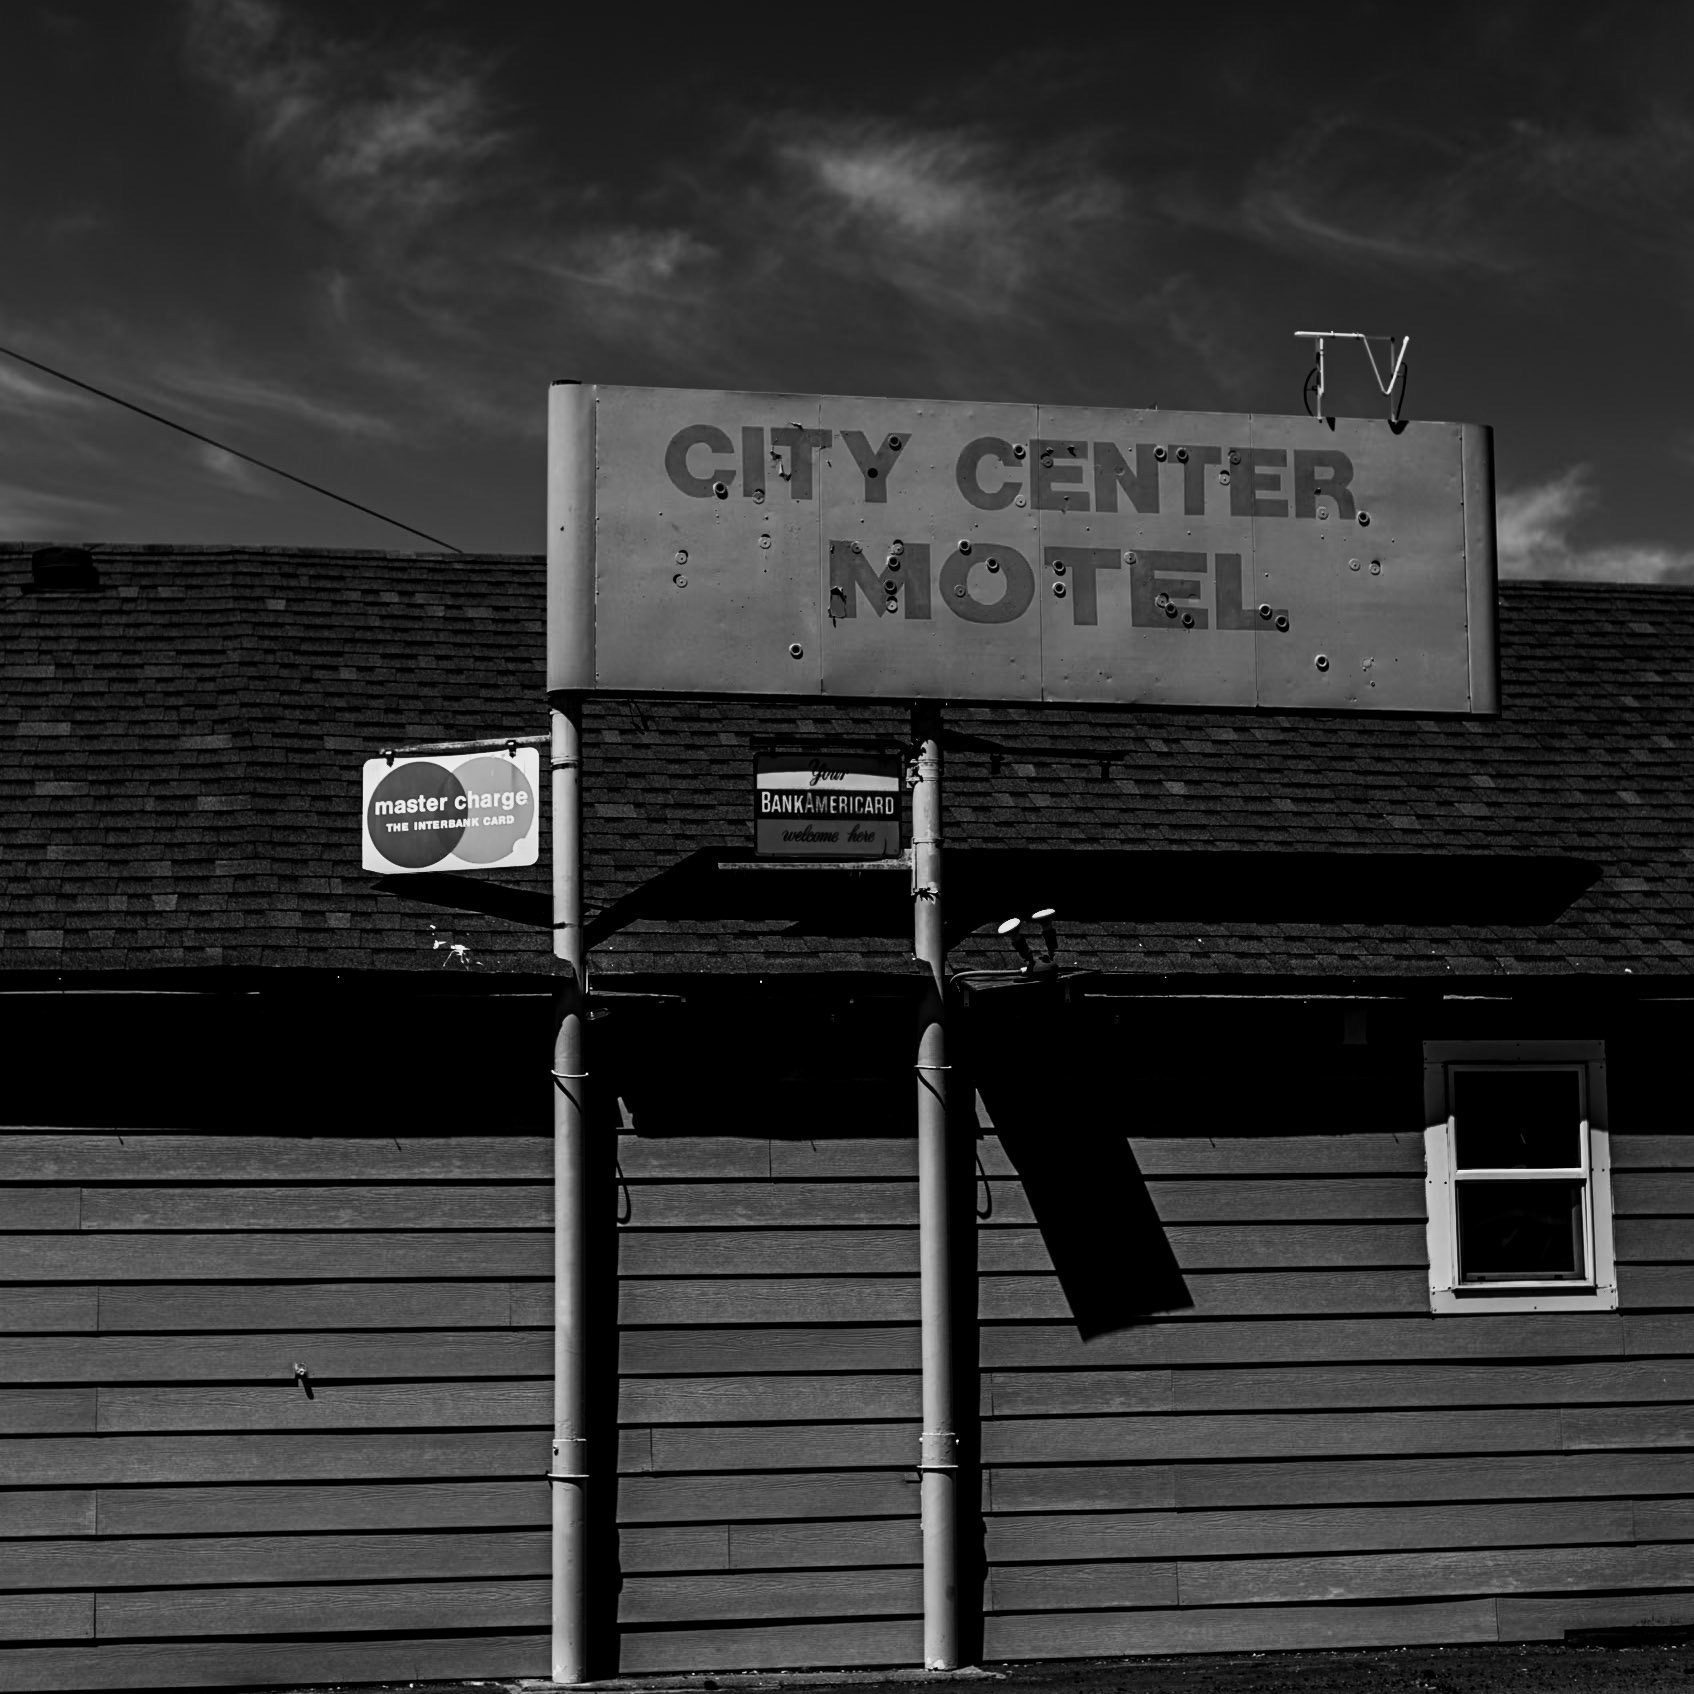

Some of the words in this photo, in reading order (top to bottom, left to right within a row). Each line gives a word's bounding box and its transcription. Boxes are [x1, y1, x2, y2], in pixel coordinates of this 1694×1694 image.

[1294, 330, 1410, 396] TV
[664, 423, 912, 503] CITY
[955, 436, 1357, 520] CENTER
[829, 539, 1289, 631] MOTEL
[808, 758, 849, 786] Your
[375, 795, 448, 815] master
[454, 790, 528, 811] charge
[761, 791, 894, 815] BANKAMERICARD
[386, 823, 409, 832] THE
[414, 818, 479, 831] INTERBANK
[483, 815, 515, 826] CARD
[782, 824, 839, 843] welcome
[847, 824, 875, 843] here
